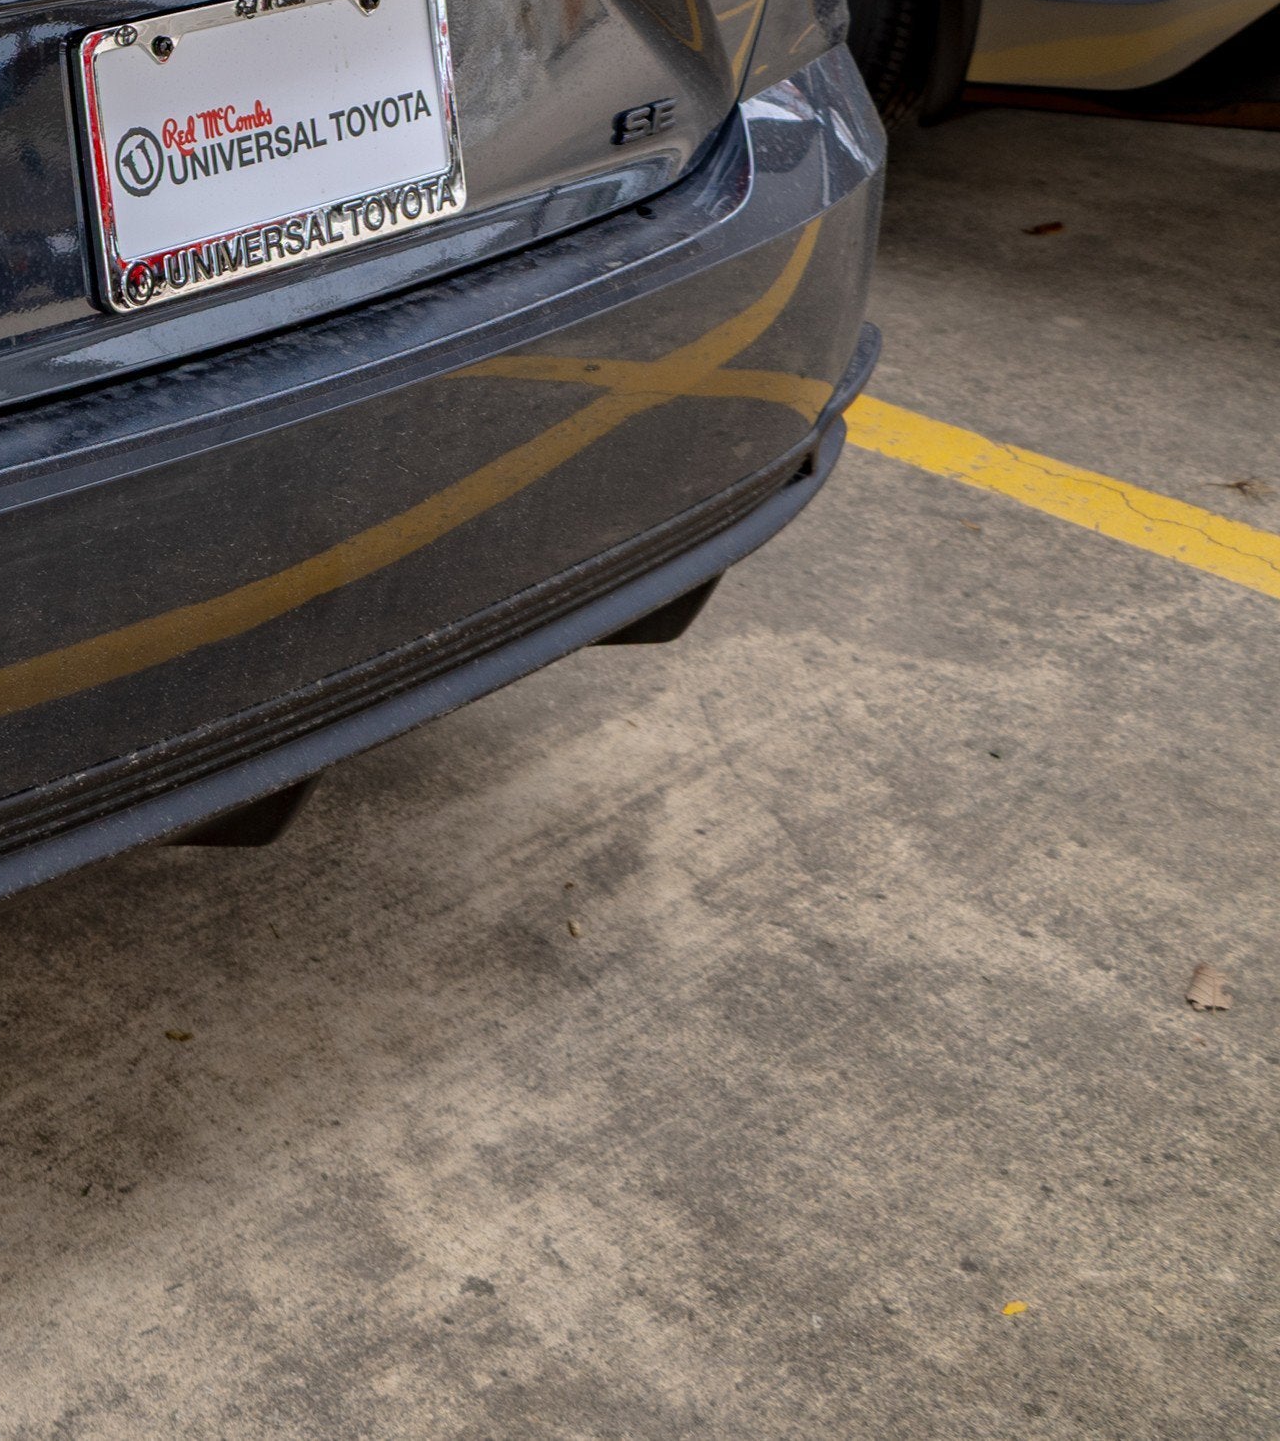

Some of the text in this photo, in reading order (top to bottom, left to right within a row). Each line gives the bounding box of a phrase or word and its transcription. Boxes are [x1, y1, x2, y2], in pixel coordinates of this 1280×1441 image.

[162, 100, 273, 156] Red McCombs
[167, 90, 432, 185] UNIVERSAL TOYOTA
[610, 97, 680, 146] SE
[164, 175, 458, 289] UNIVERSAL TOYOTA
